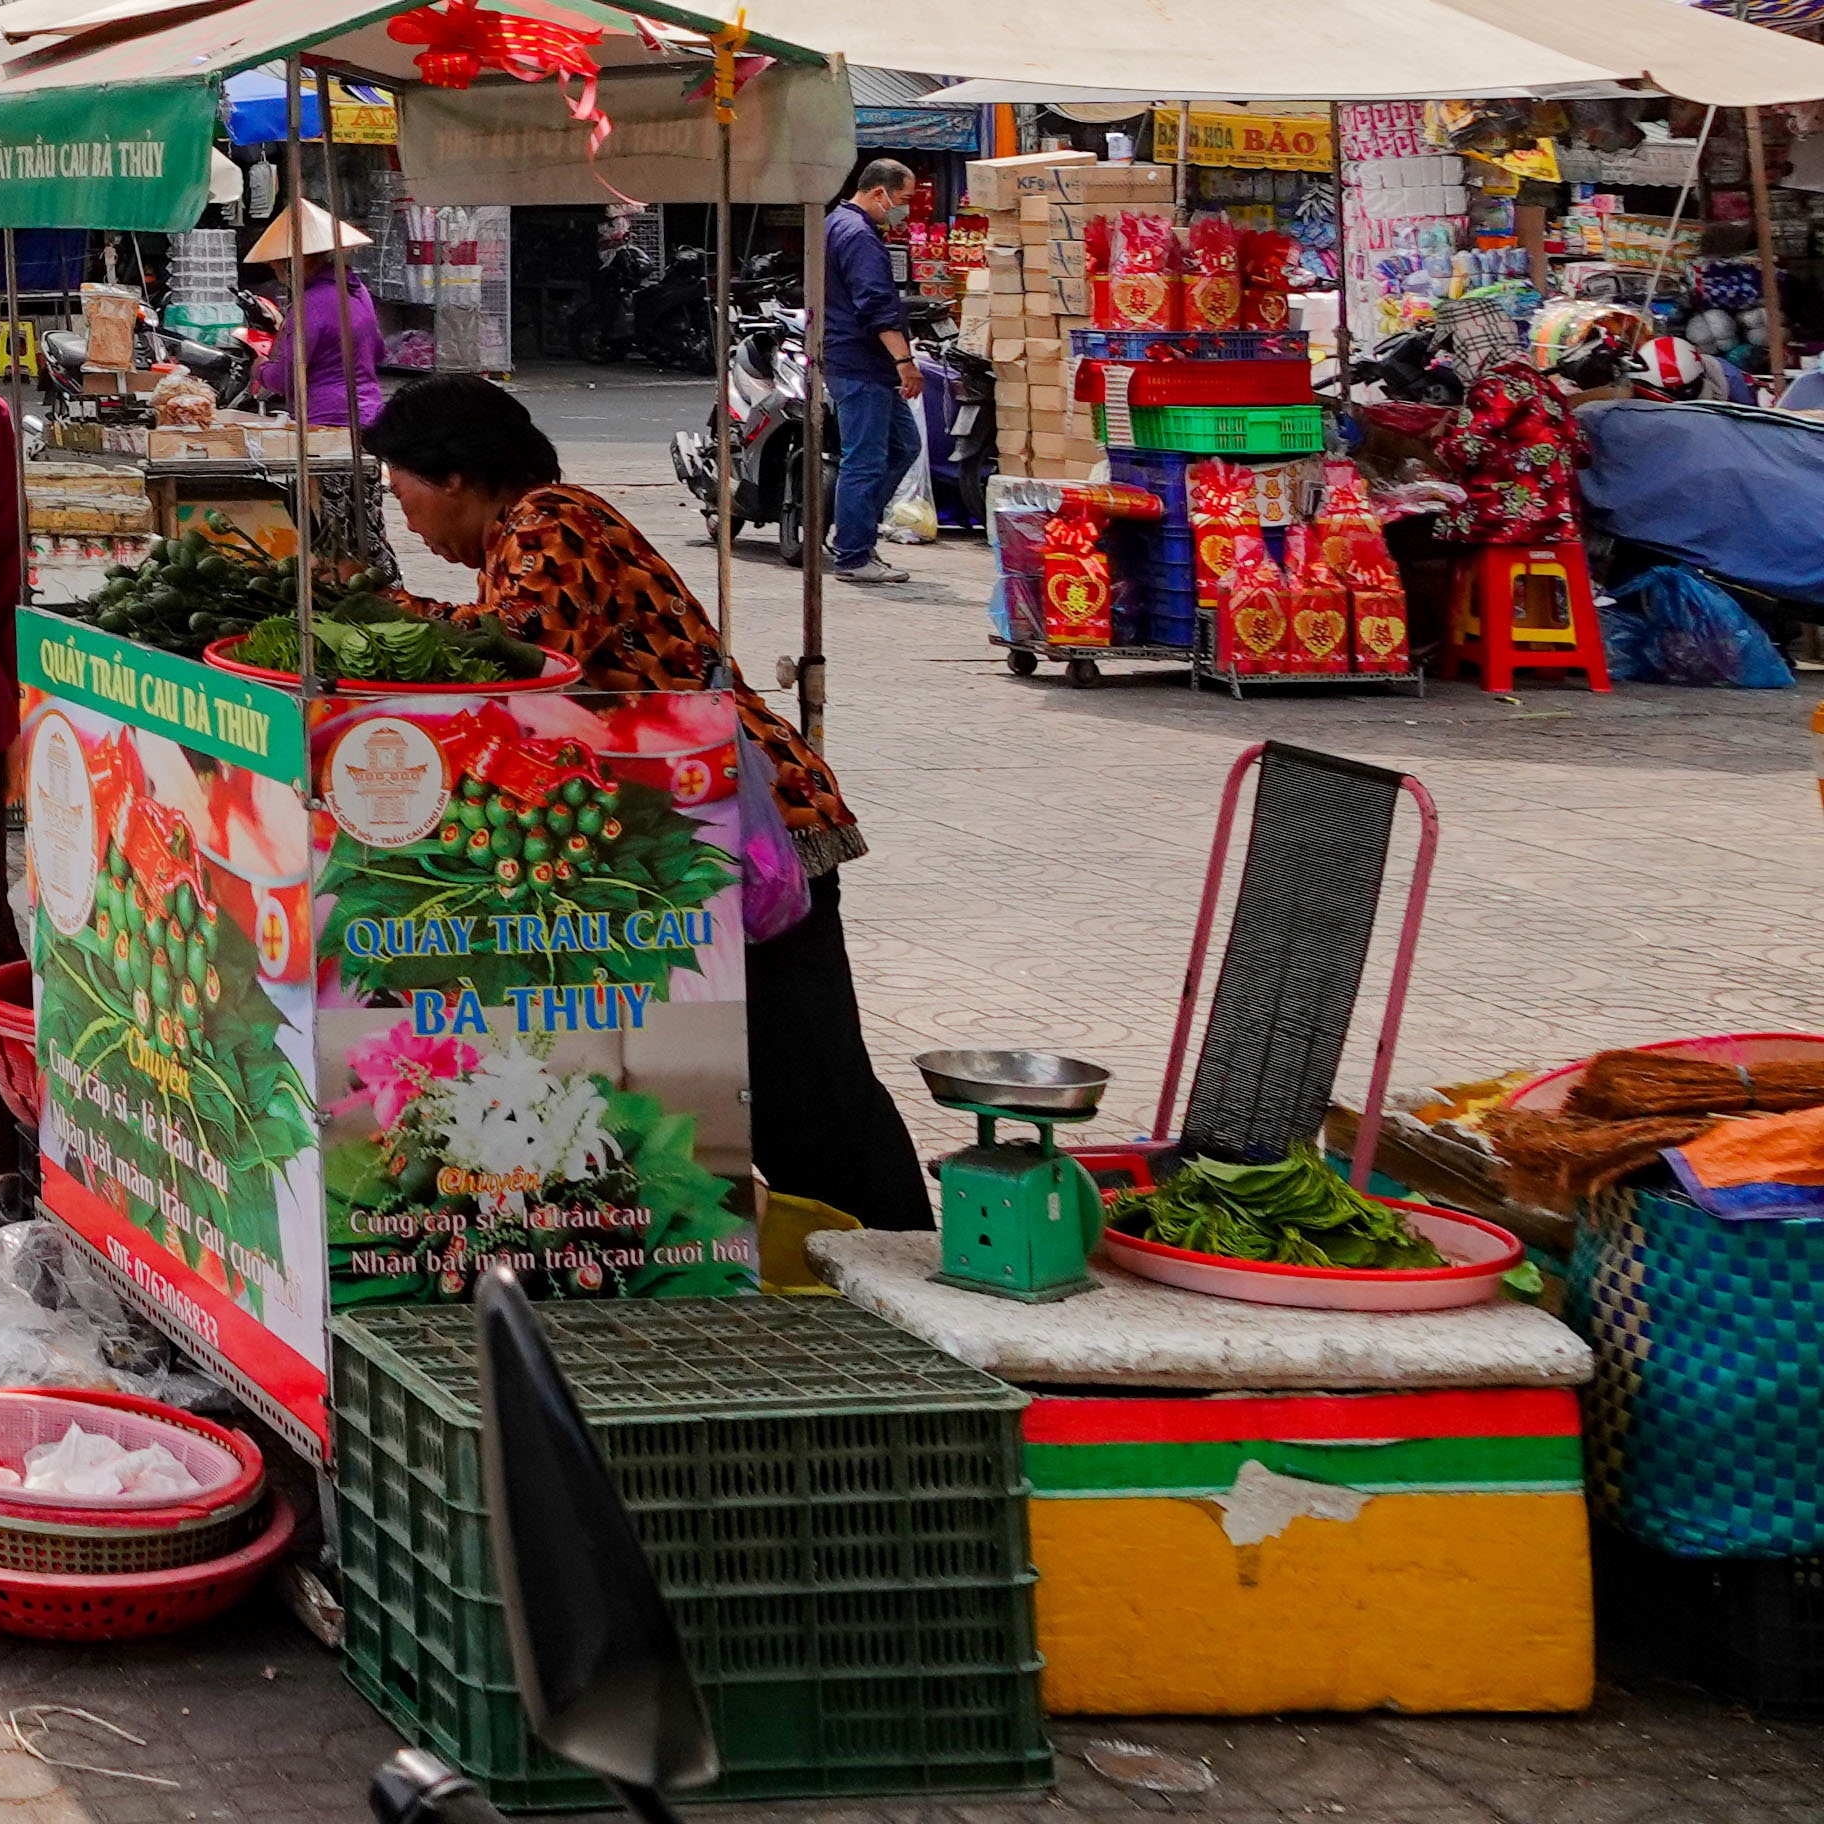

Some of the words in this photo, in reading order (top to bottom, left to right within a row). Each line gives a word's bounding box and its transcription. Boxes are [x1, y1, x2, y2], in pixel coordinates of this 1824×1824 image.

[15, 134, 56, 179] TRẦU
[59, 142, 91, 178] CAU
[93, 134, 112, 177] BÀ
[117, 129, 165, 178] THỦY
[40, 634, 87, 690] QUẦY
[89, 650, 138, 710] TRẦU
[140, 673, 180, 725] CAU
[182, 681, 213, 736] BÀ
[214, 693, 271, 757] THỦY
[345, 903, 479, 963] QUẦY
[488, 903, 611, 955] TRẦU
[623, 907, 714, 950] CAU
[409, 977, 489, 1038] BÀ
[504, 967, 656, 1036] THỦY
[128, 1027, 192, 1102] Chuyên
[198, 1148, 229, 1194] cau
[437, 1165, 543, 1199] Chuyên
[196, 1216, 226, 1261] cau
[609, 1207, 651, 1227] cau
[352, 1249, 418, 1280] Nhận
[475, 1249, 537, 1272] mâm
[602, 1247, 645, 1268] cau
